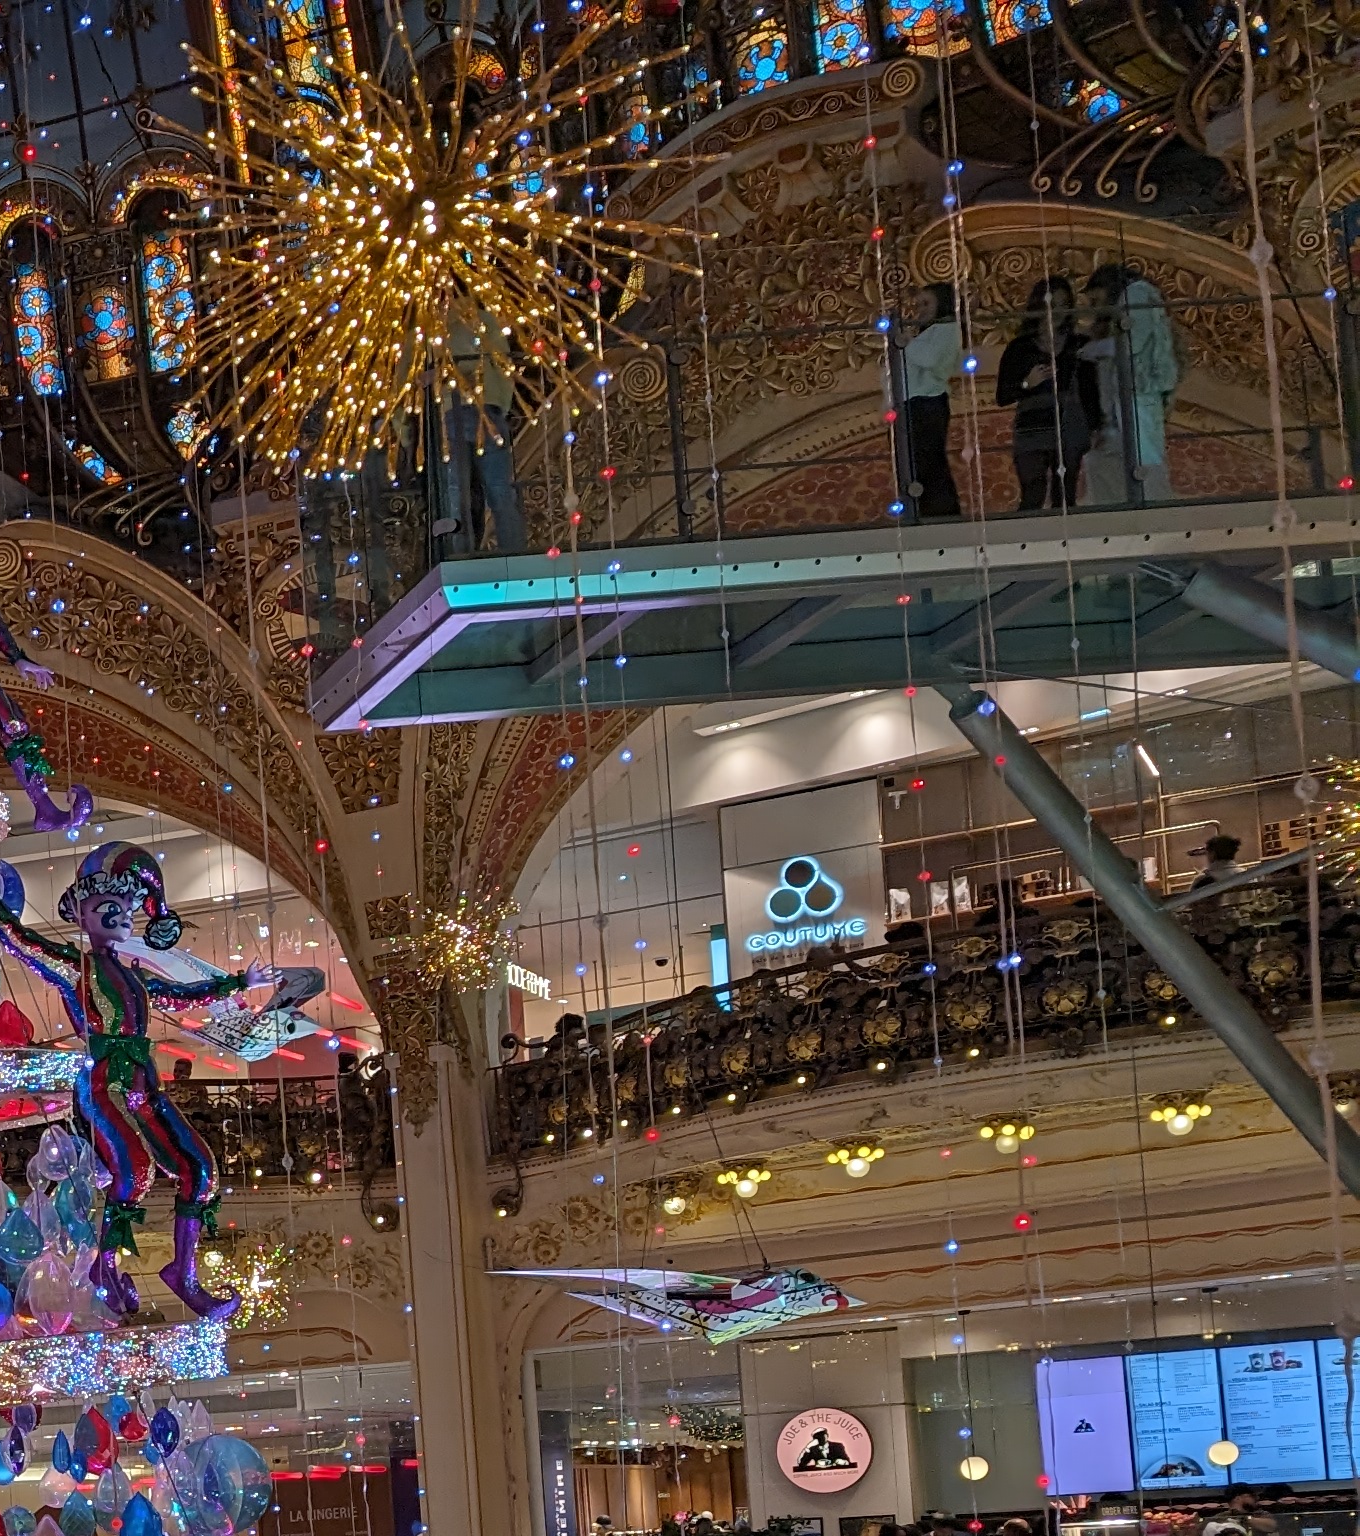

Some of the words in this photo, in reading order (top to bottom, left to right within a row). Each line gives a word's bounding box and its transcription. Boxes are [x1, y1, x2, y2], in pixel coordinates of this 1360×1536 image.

[747, 919, 866, 949] COUTUME
[783, 1425, 800, 1445] JOE
[798, 1418, 809, 1428] &
[809, 1413, 832, 1424] THE
[833, 1416, 864, 1441] JUICE
